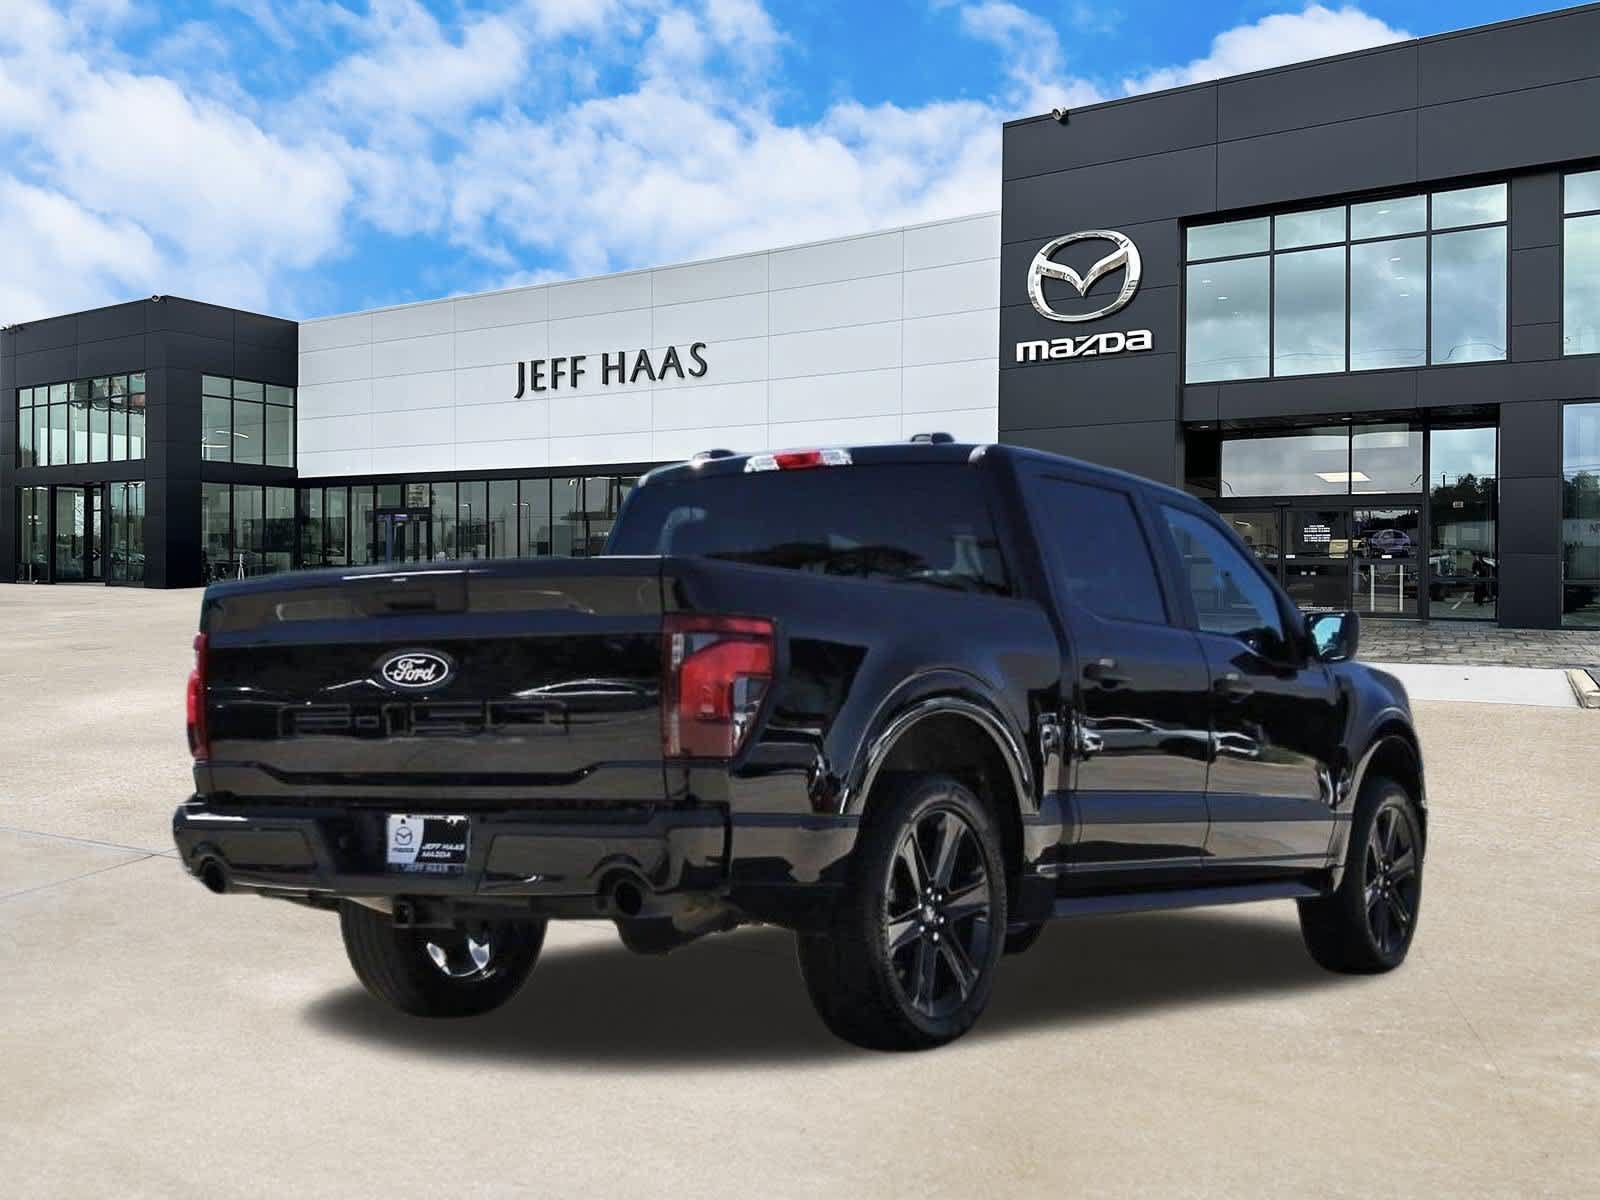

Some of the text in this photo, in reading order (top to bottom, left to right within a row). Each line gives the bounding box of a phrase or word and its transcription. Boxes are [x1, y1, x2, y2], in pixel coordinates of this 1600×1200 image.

[1016, 329, 1152, 362] mazda
[514, 342, 708, 399] JEFF HAAS
[388, 658, 436, 681] Ford
